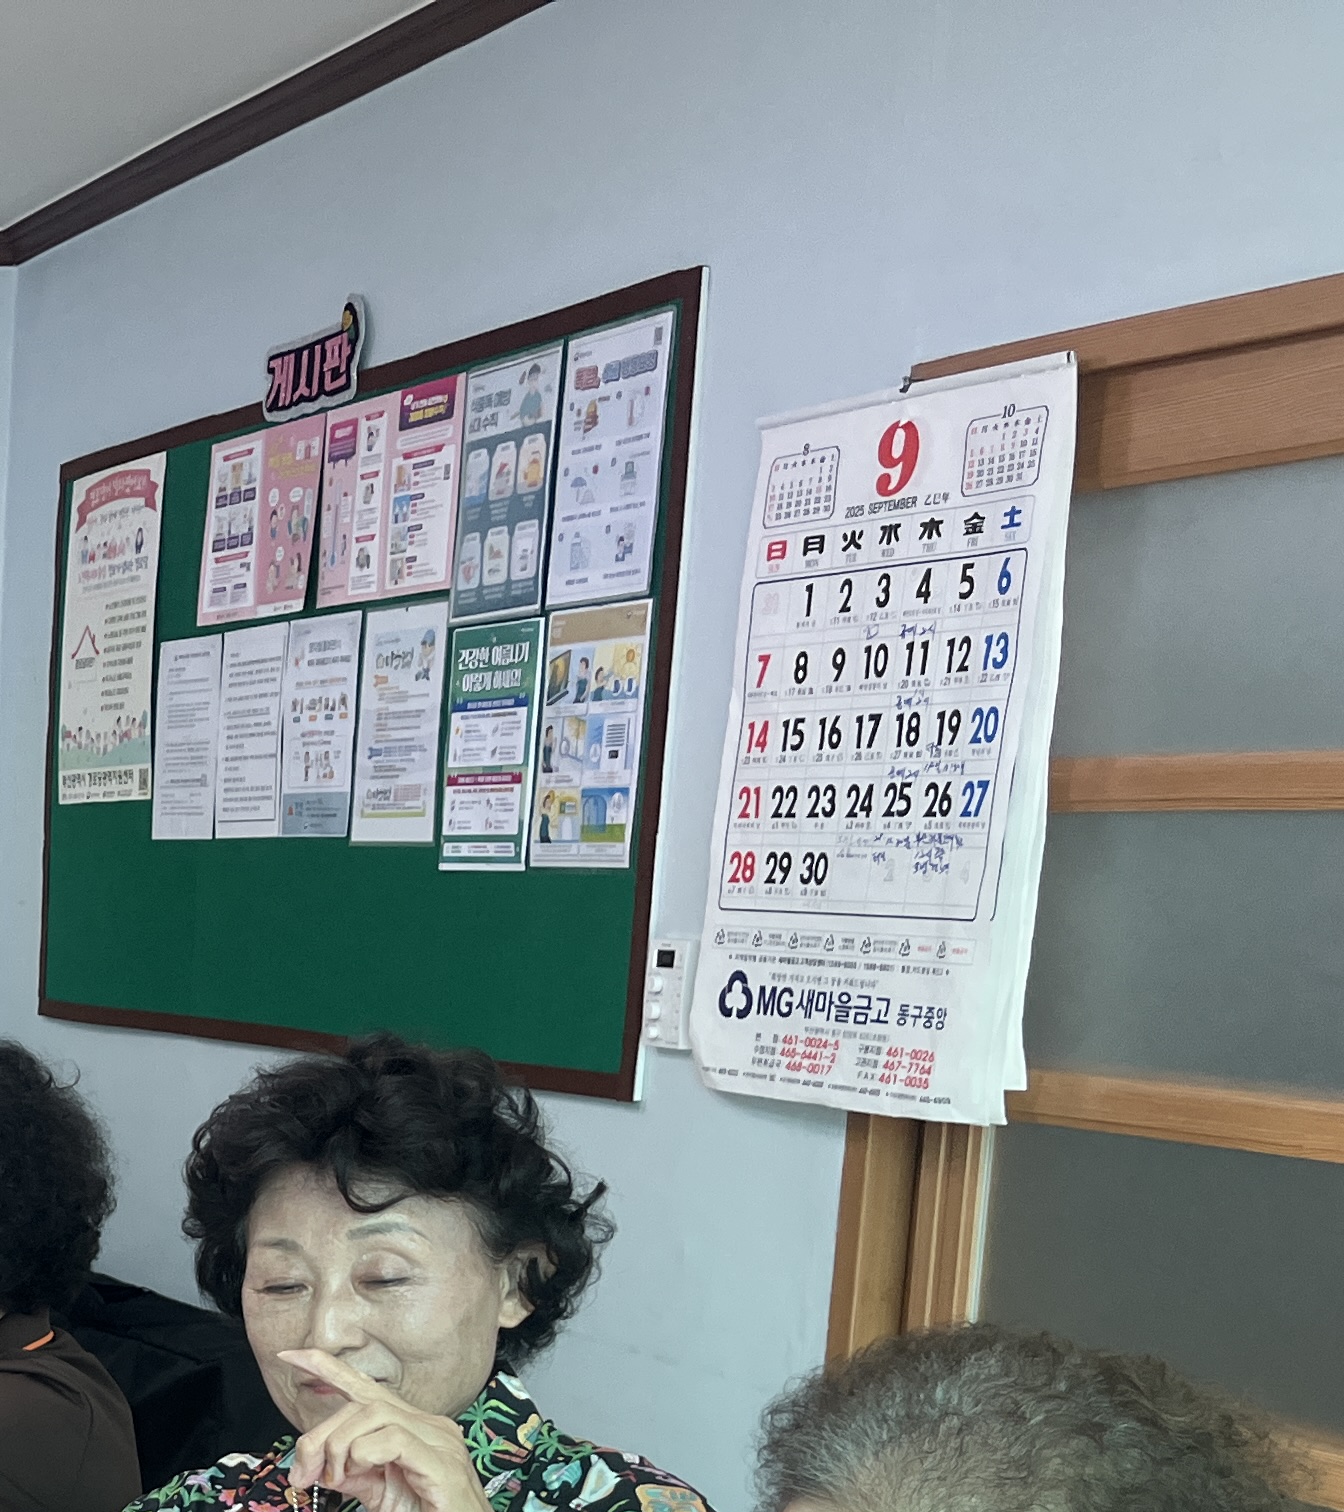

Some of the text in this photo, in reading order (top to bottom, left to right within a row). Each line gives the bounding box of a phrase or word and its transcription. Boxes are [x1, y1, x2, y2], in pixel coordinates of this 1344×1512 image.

[265, 330, 353, 409] 게시판
[1001, 403, 1016, 420] 10
[802, 443, 811, 457] 8
[875, 419, 921, 498] 9
[843, 504, 866, 519] 2025
[867, 496, 919, 516] SEPTEMBER
[805, 582, 814, 617] 1
[838, 578, 853, 614] 2
[875, 572, 891, 609] 3
[915, 567, 933, 604] 4
[958, 562, 975, 600] 5
[997, 556, 1012, 600] 6
[457, 640, 531, 671] 건강한 여름나기
[755, 653, 771, 688] 7
[793, 650, 809, 685] 8
[831, 647, 846, 682] 9
[864, 643, 889, 680] 10
[905, 639, 930, 677] 11
[946, 634, 972, 674] 12
[982, 631, 1009, 671] 13
[745, 720, 769, 755] 14
[781, 717, 806, 753] 15
[818, 715, 842, 751] 16
[855, 713, 883, 750] 17
[895, 711, 921, 748] 18
[936, 708, 962, 746] 19
[969, 706, 999, 744] 20
[736, 779, 991, 820] 21 22 23 24 25 26 27
[726, 851, 756, 885] 28
[763, 851, 792, 885] 29
[799, 851, 829, 886] 30
[896, 1003, 949, 1032] 동구중앙
[781, 1033, 840, 1051] 461-0024-5
[886, 1046, 936, 1063] 461-0026
[882, 1059, 932, 1076] 467-7764
